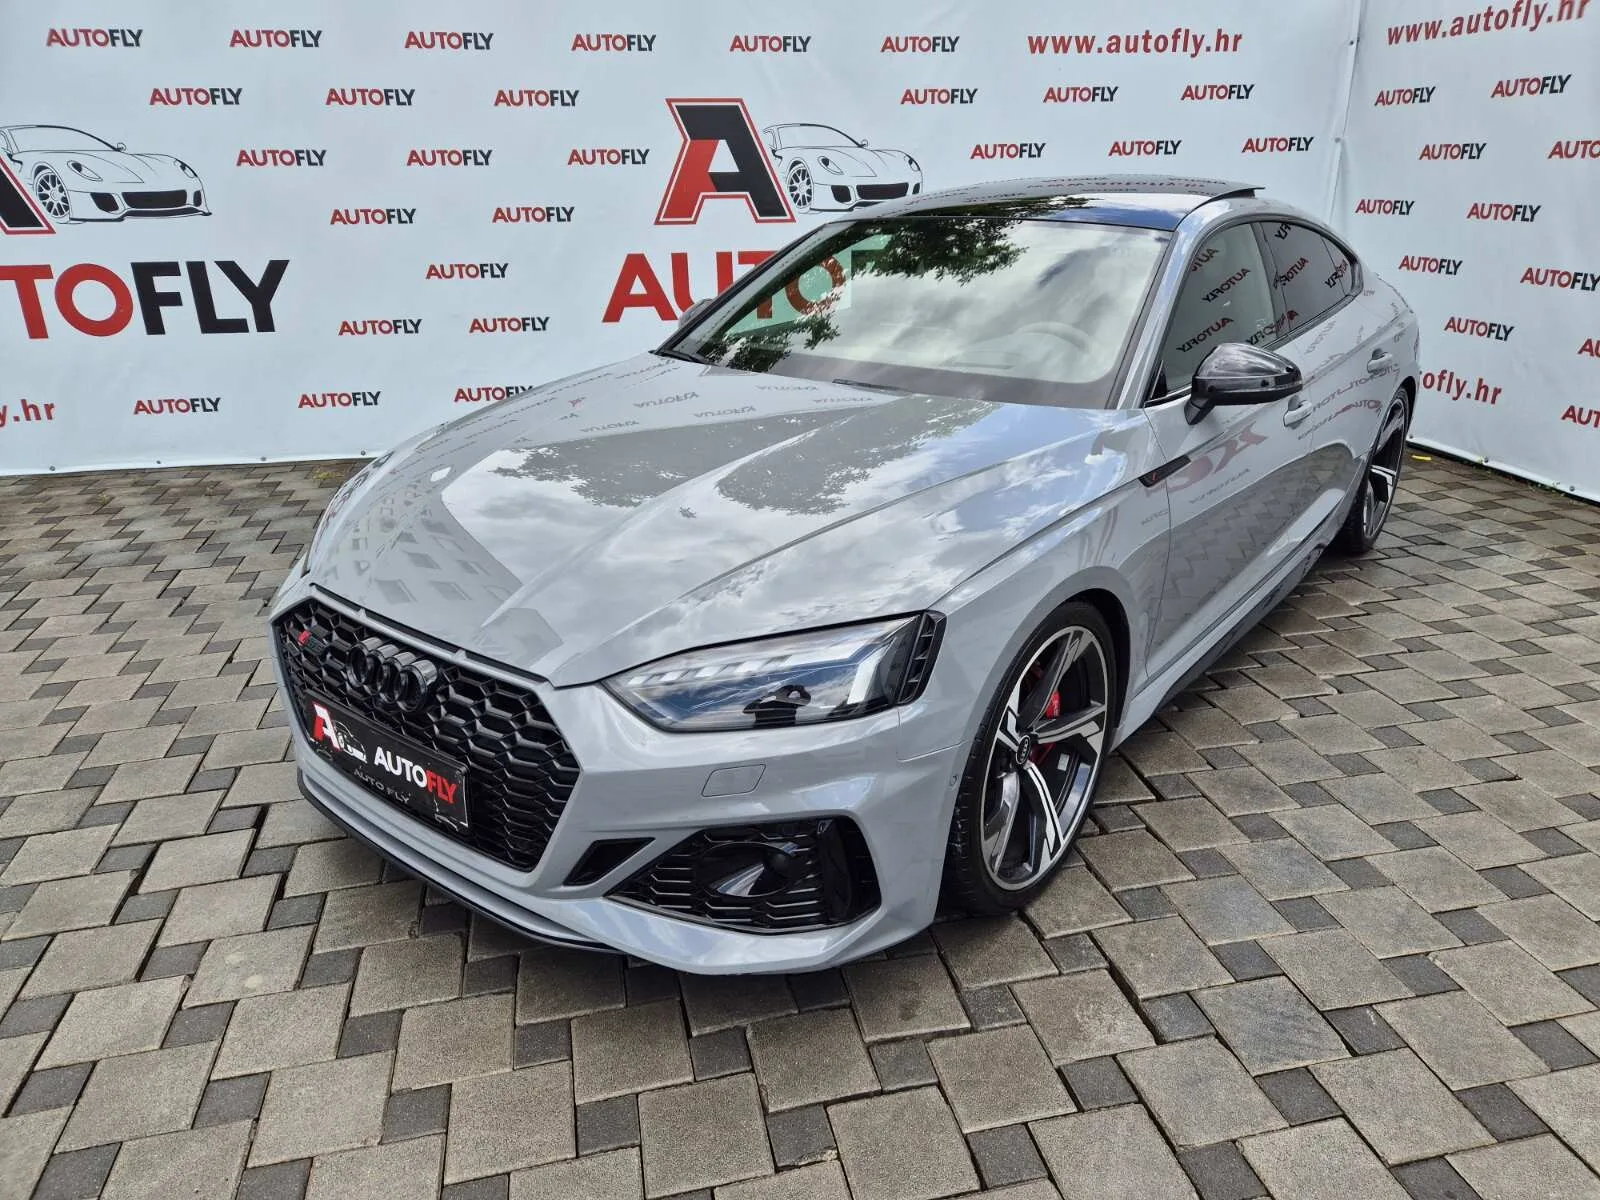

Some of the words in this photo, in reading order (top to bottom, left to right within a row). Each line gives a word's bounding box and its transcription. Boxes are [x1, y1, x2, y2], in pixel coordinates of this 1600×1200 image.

[1387, 0, 1591, 46] www.autofly.hr
[46, 28, 144, 48] AUTOFLY
[229, 29, 323, 48] AUTOFLY
[404, 31, 495, 51] AUTOFLY
[571, 33, 657, 52] AUTOFLY
[729, 35, 812, 53] AUTOFLY
[880, 35, 961, 53] AUTOFLY
[1027, 27, 1243, 59] www.autofly.hr
[1042, 85, 1120, 104] AUTOFLY
[1180, 83, 1255, 101] AUTOFLY
[1490, 73, 1573, 99] AUTOFLY
[149, 87, 243, 106] AUTOFLY
[325, 87, 416, 107] AUTOFLY
[493, 89, 580, 108] AUTOFLY
[900, 87, 979, 105] AUTOFLY
[1373, 85, 1437, 107] AUTOFLY
[970, 142, 1047, 160] AUTOFLY
[1108, 139, 1183, 157] AUTOFLY
[1241, 136, 1315, 154] AUTOFLY
[1418, 142, 1488, 161] AUTOFLY
[236, 148, 327, 167] AUTOFLY
[406, 149, 493, 167] AUTOFLY
[567, 148, 650, 166] AUTOFLY
[329, 207, 417, 226] AUTOFLY
[491, 206, 576, 224] AUTOFLY
[1354, 198, 1416, 216] AUTOFLY
[1466, 202, 1542, 223] AUTOFLY
[425, 262, 510, 280] AUTOFLY
[1398, 254, 1464, 276] AUTOFLY
[1519, 267, 1600, 292] AUTOFLY
[338, 318, 423, 336] AUTOFLY
[468, 316, 551, 334] AUTOFLY
[1443, 316, 1516, 342] AUTOFLY
[1419, 369, 1503, 405] ofly.hr
[133, 396, 222, 415] AUTOFLY
[297, 390, 382, 409] AUTOFLY
[373, 746, 457, 804] AUTOFLY
